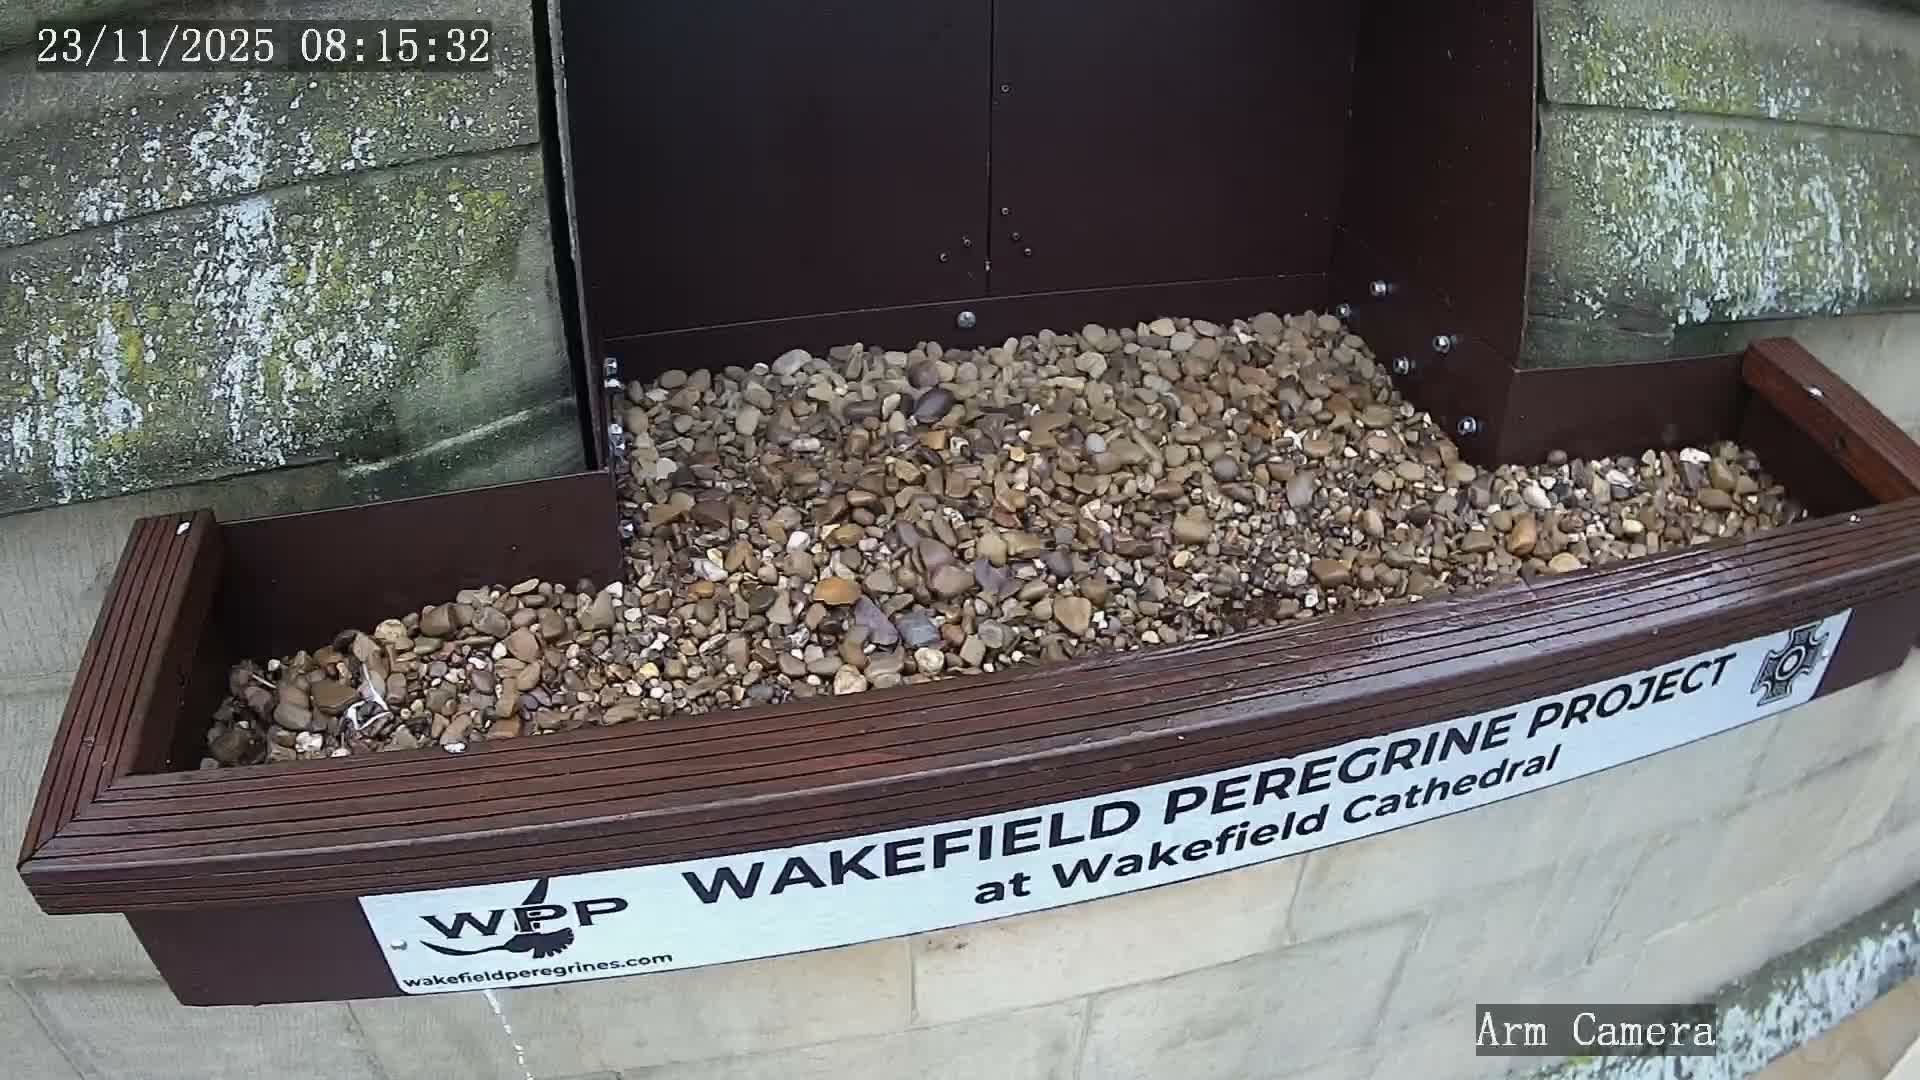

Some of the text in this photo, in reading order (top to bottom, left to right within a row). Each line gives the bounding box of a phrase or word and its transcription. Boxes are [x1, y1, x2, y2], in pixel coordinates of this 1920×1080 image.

[682, 652, 1737, 904] WAKEFIELD PEREGRINE PROJECT
[974, 743, 1562, 905] at Wakefield Cathedral
[419, 897, 629, 939] WPP
[403, 953, 673, 988] wakefieldperegrines.com
